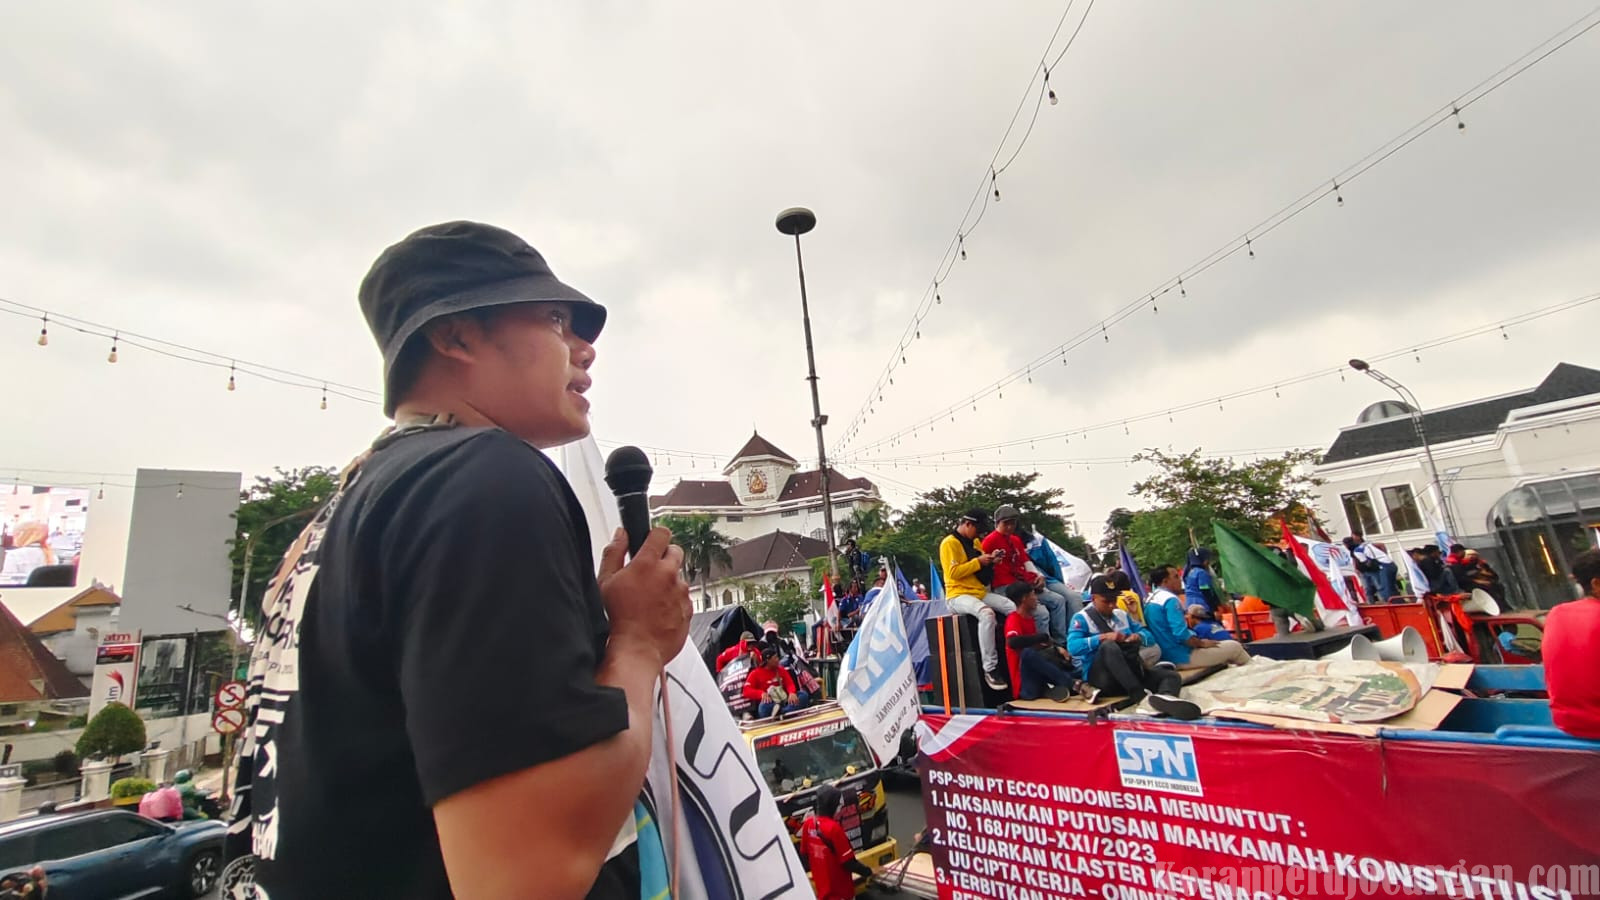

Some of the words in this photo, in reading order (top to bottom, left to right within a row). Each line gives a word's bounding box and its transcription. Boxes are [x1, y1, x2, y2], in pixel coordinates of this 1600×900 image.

[104, 633, 131, 642] atm
[1119, 737, 1193, 777] SPN
[928, 769, 985, 791] PSP-SPN
[986, 777, 1003, 794] PT
[1006, 780, 1050, 800] ECCO
[1052, 785, 1158, 814] INDONESIA
[1159, 796, 1292, 835] MENUNTUT
[946, 811, 972, 831] NO.
[1057, 809, 1160, 841] PUTUSAN
[1162, 823, 1330, 874] MAHKAMAH
[949, 850, 970, 870] UU
[973, 856, 1022, 883] CIPTA
[1024, 867, 1086, 897] KERJA
[1050, 851, 1147, 887] KLASTER
